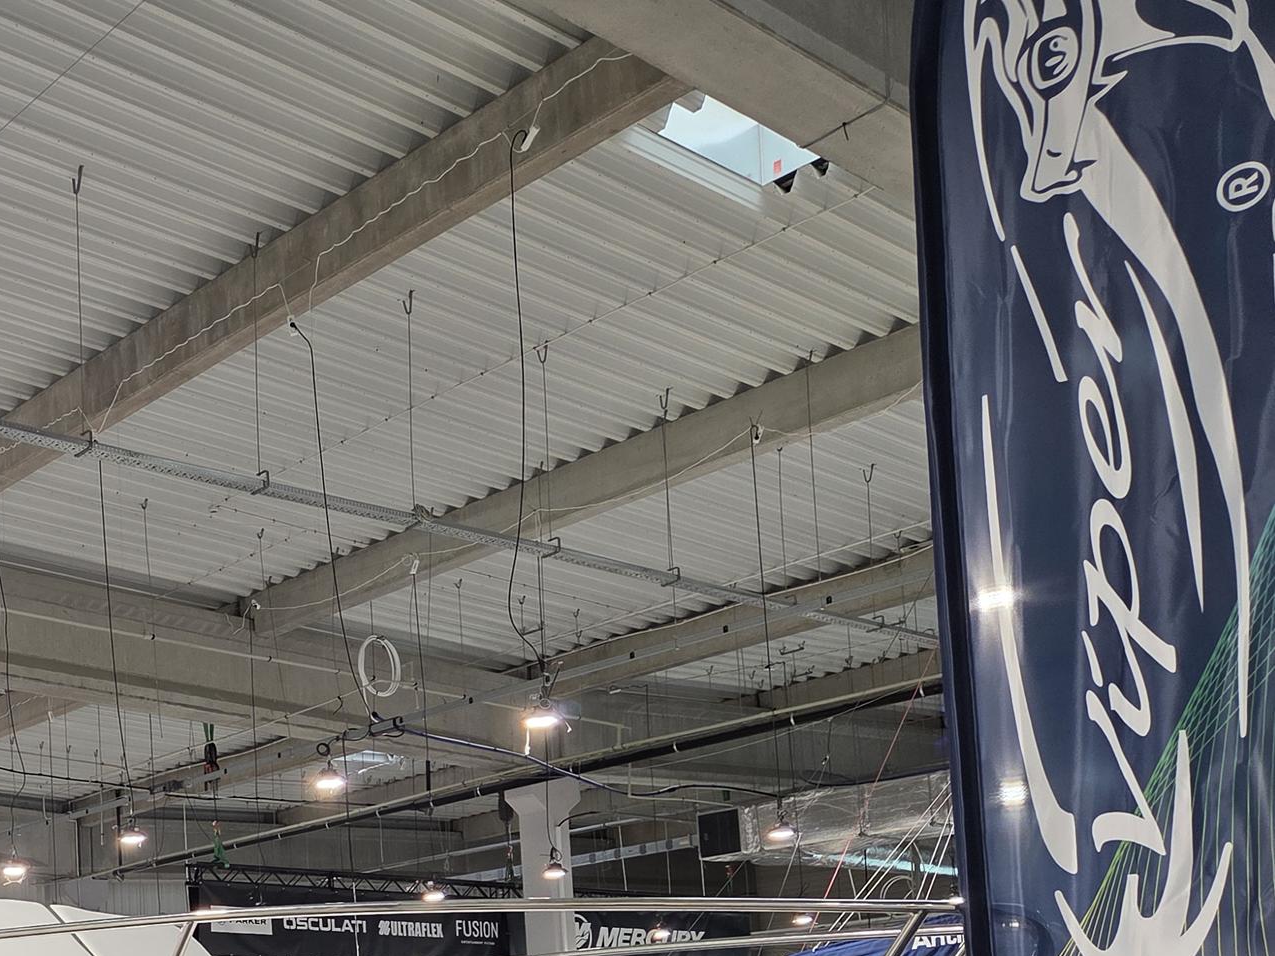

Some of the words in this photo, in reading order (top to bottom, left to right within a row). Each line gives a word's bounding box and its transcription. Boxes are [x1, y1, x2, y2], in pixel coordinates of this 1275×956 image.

[1062, 211, 1178, 856] Viper
[282, 917, 367, 933] OSCULATI
[390, 920, 444, 938] ULTRAFLEX
[455, 919, 499, 939] FUSION
